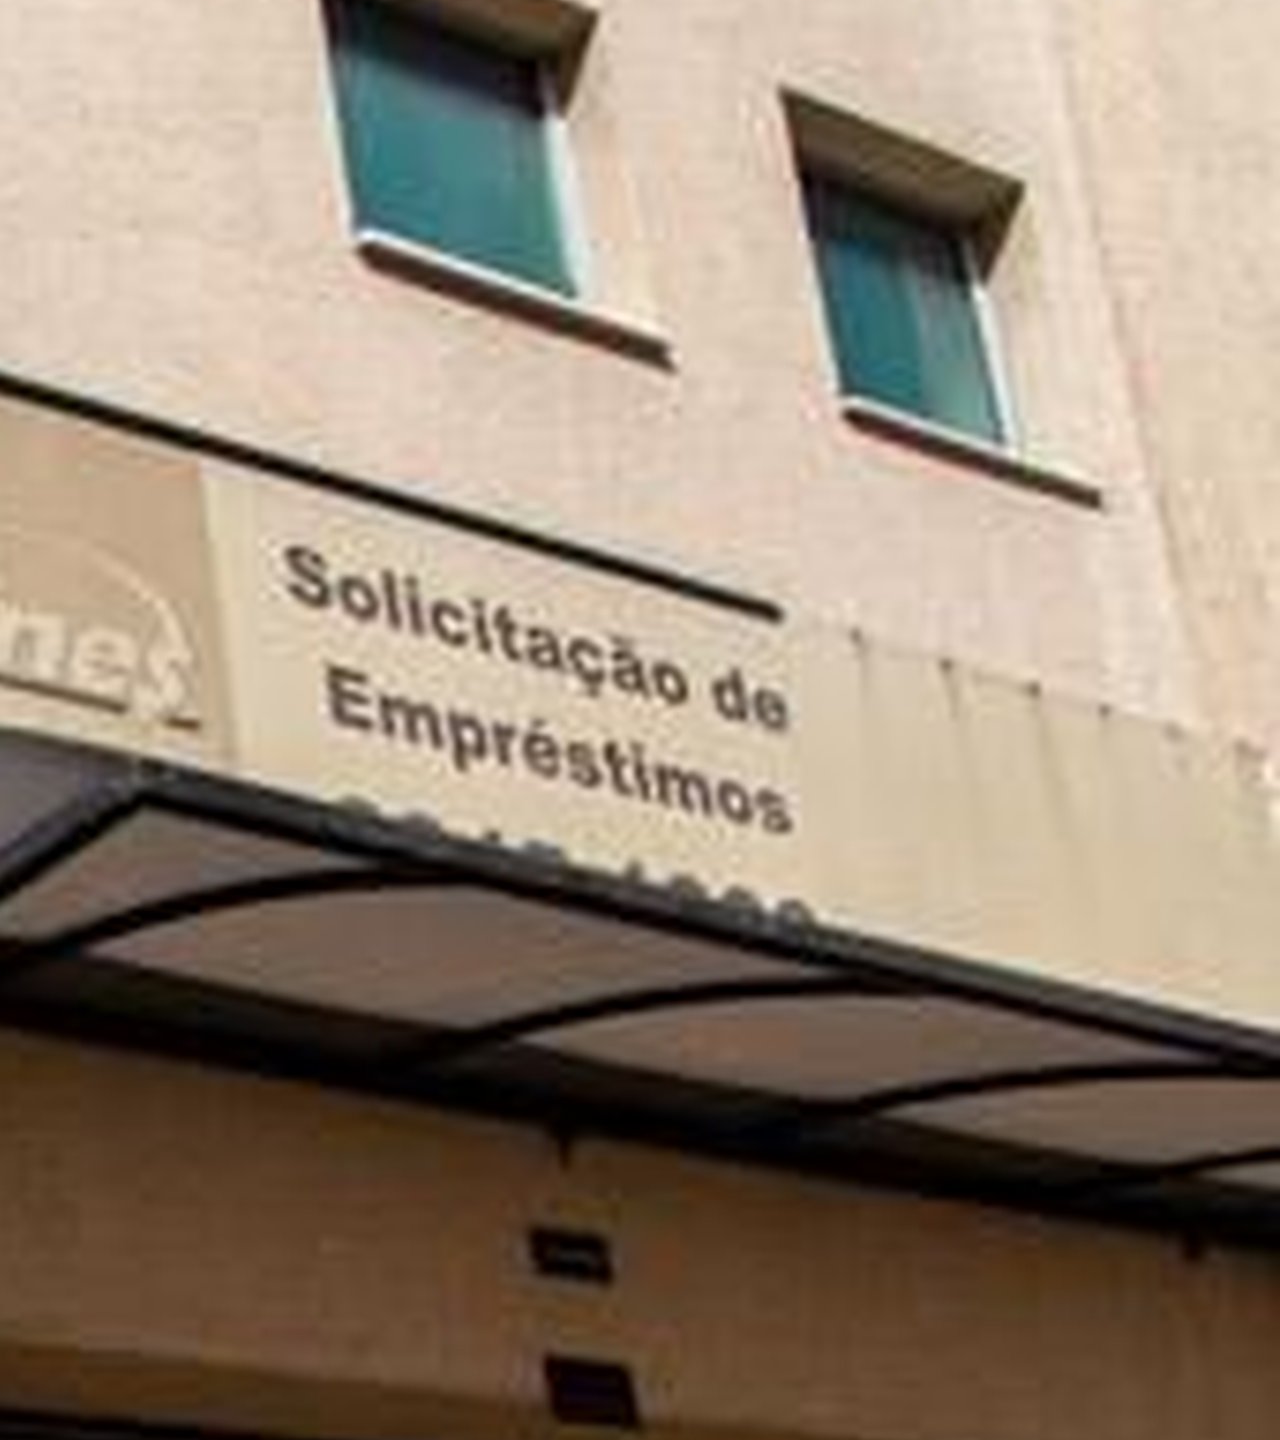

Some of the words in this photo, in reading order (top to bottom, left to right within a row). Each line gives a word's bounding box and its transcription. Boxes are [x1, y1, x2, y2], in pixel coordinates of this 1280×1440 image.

[282, 544, 690, 708] Solicitação
[711, 668, 790, 732] de
[324, 663, 795, 836] Empréstimos
